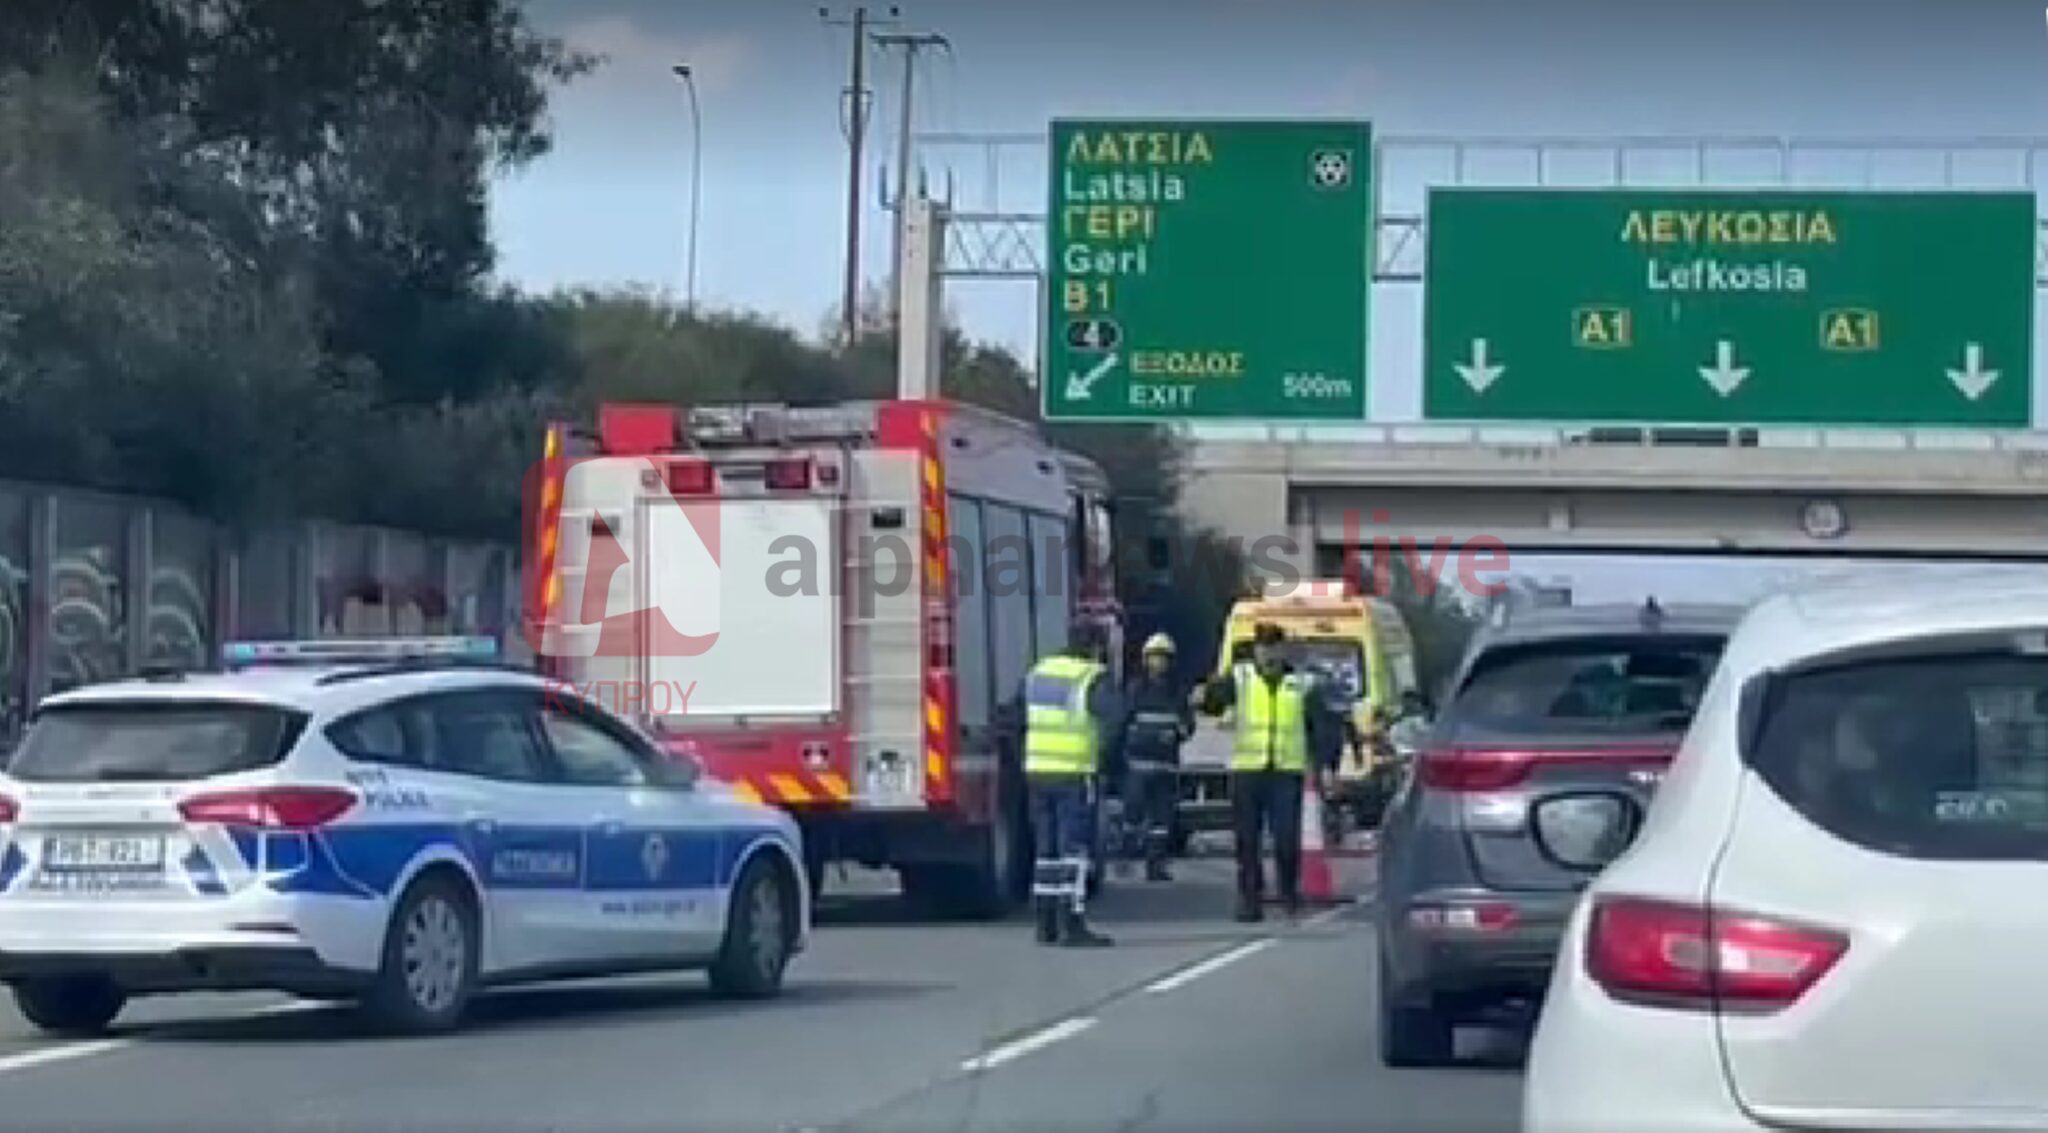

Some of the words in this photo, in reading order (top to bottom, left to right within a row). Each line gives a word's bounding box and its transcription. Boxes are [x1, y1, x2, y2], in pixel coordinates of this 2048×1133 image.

[1066, 131, 1213, 164] ΛΑΤΣΙΑ
[1064, 170, 1185, 201] Latsia
[1063, 205, 1154, 238] ΓΕΡΙ
[1621, 209, 1836, 243] ΛΕΥΚΩΣΙΑ
[1063, 243, 1147, 274] Geri
[1648, 258, 1807, 290] Lefkosia
[1581, 311, 1627, 343] A1
[1827, 313, 1874, 345] A1
[1128, 383, 1196, 405] EXIT
